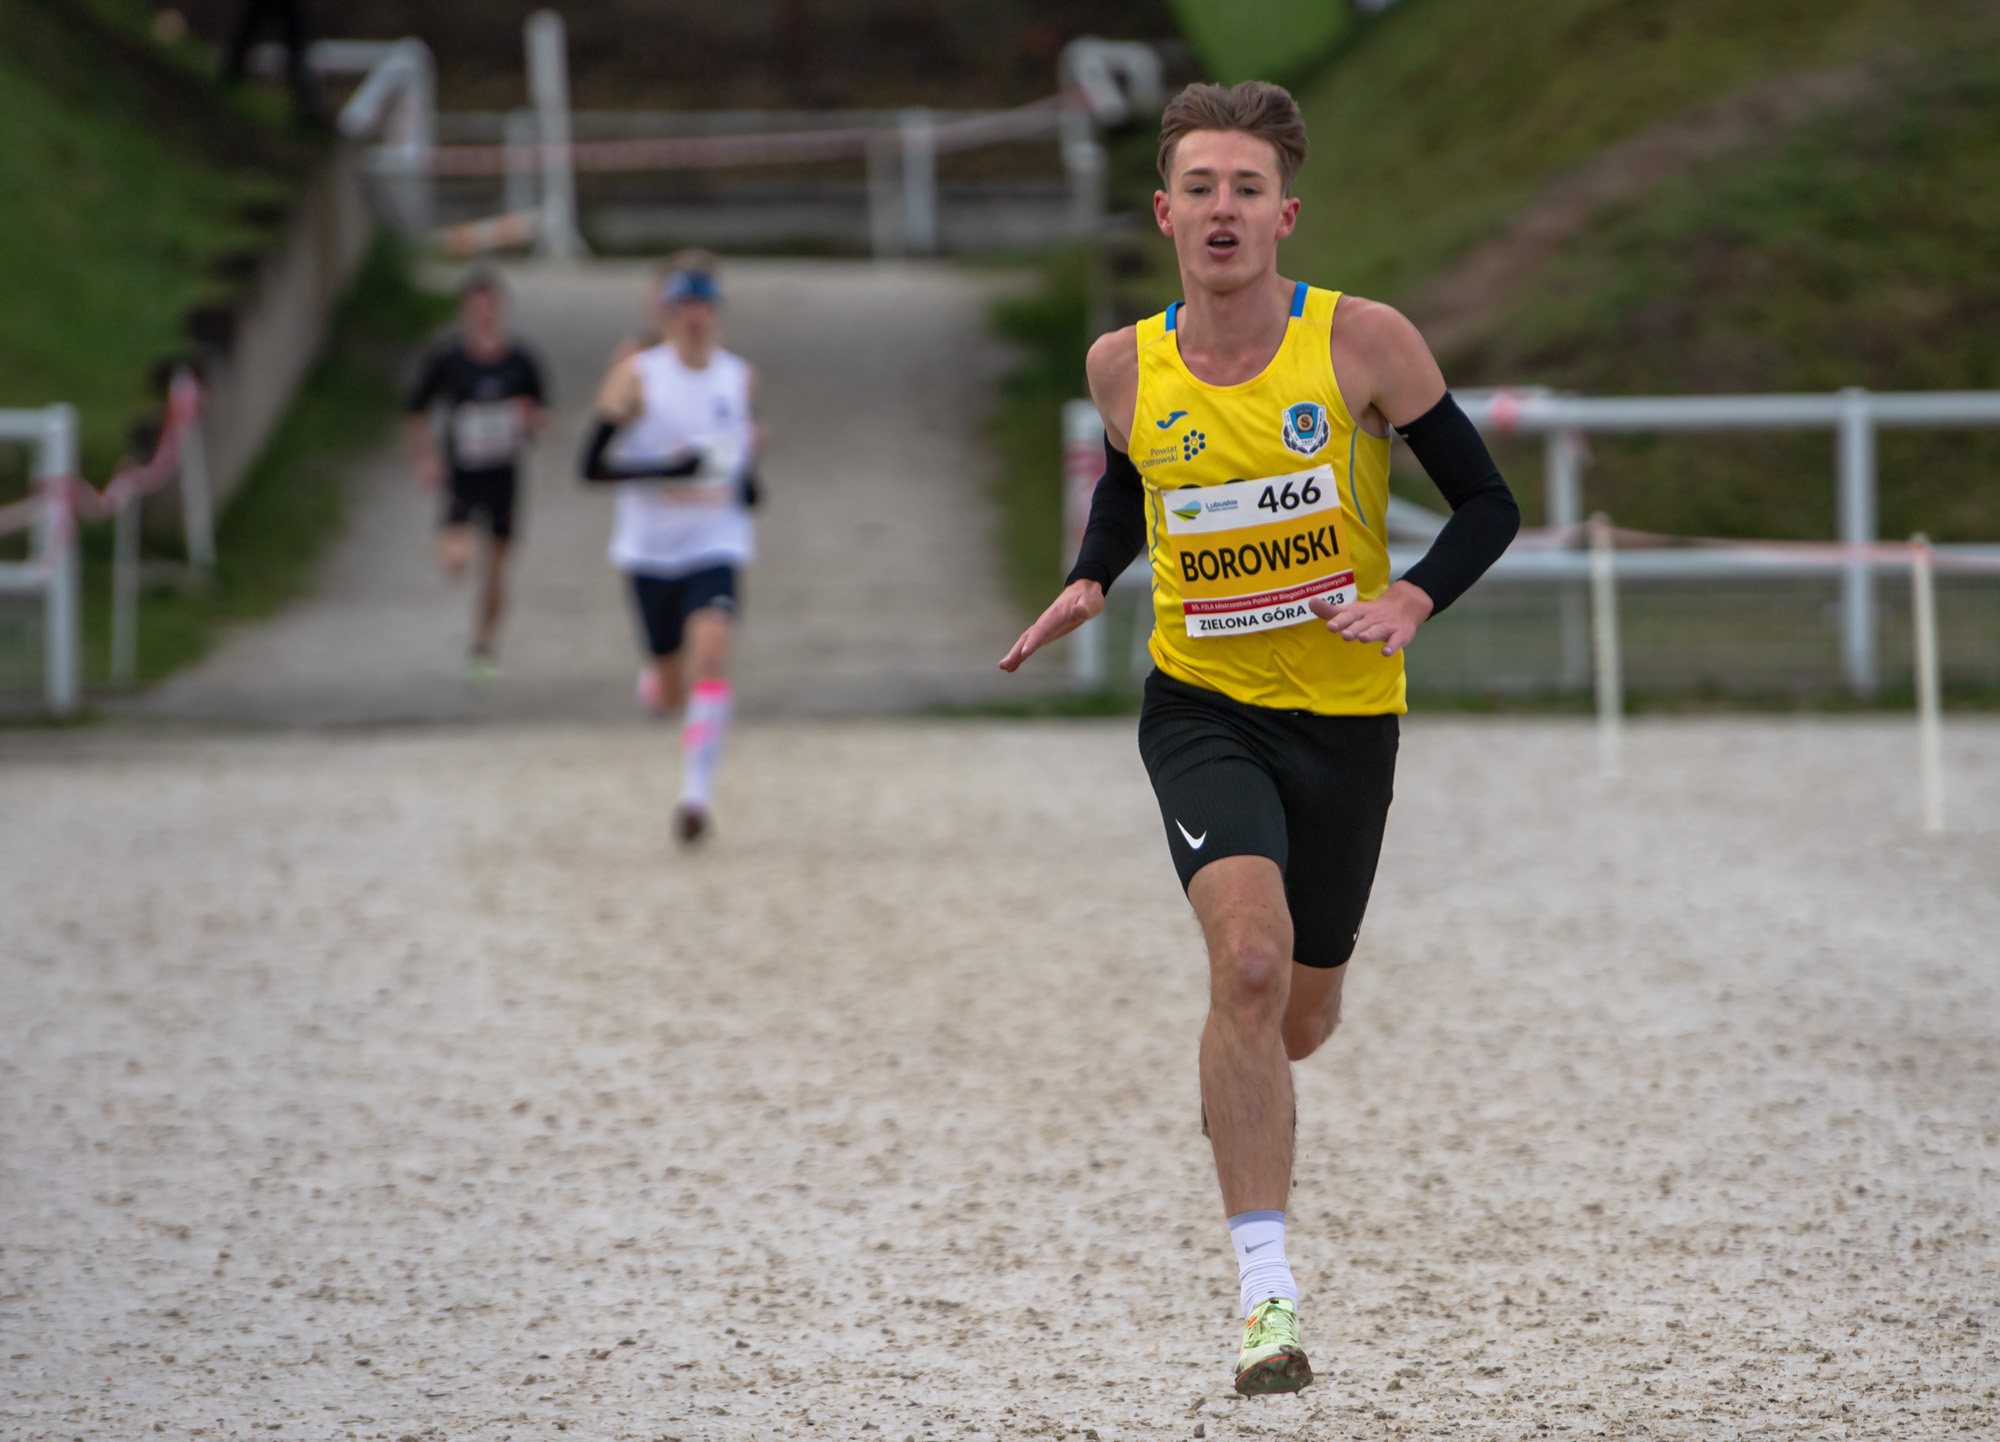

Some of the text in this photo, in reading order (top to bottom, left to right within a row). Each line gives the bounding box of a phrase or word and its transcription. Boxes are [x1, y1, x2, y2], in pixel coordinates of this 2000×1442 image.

[1142, 453, 1178, 468] Ostrowski
[1150, 445, 1177, 456] Powiat
[1257, 476, 1321, 513] 466
[1179, 525, 1340, 582] BOROWSKI
[1199, 614, 1259, 630] ZIELONA
[1262, 606, 1307, 623] GÓRA
